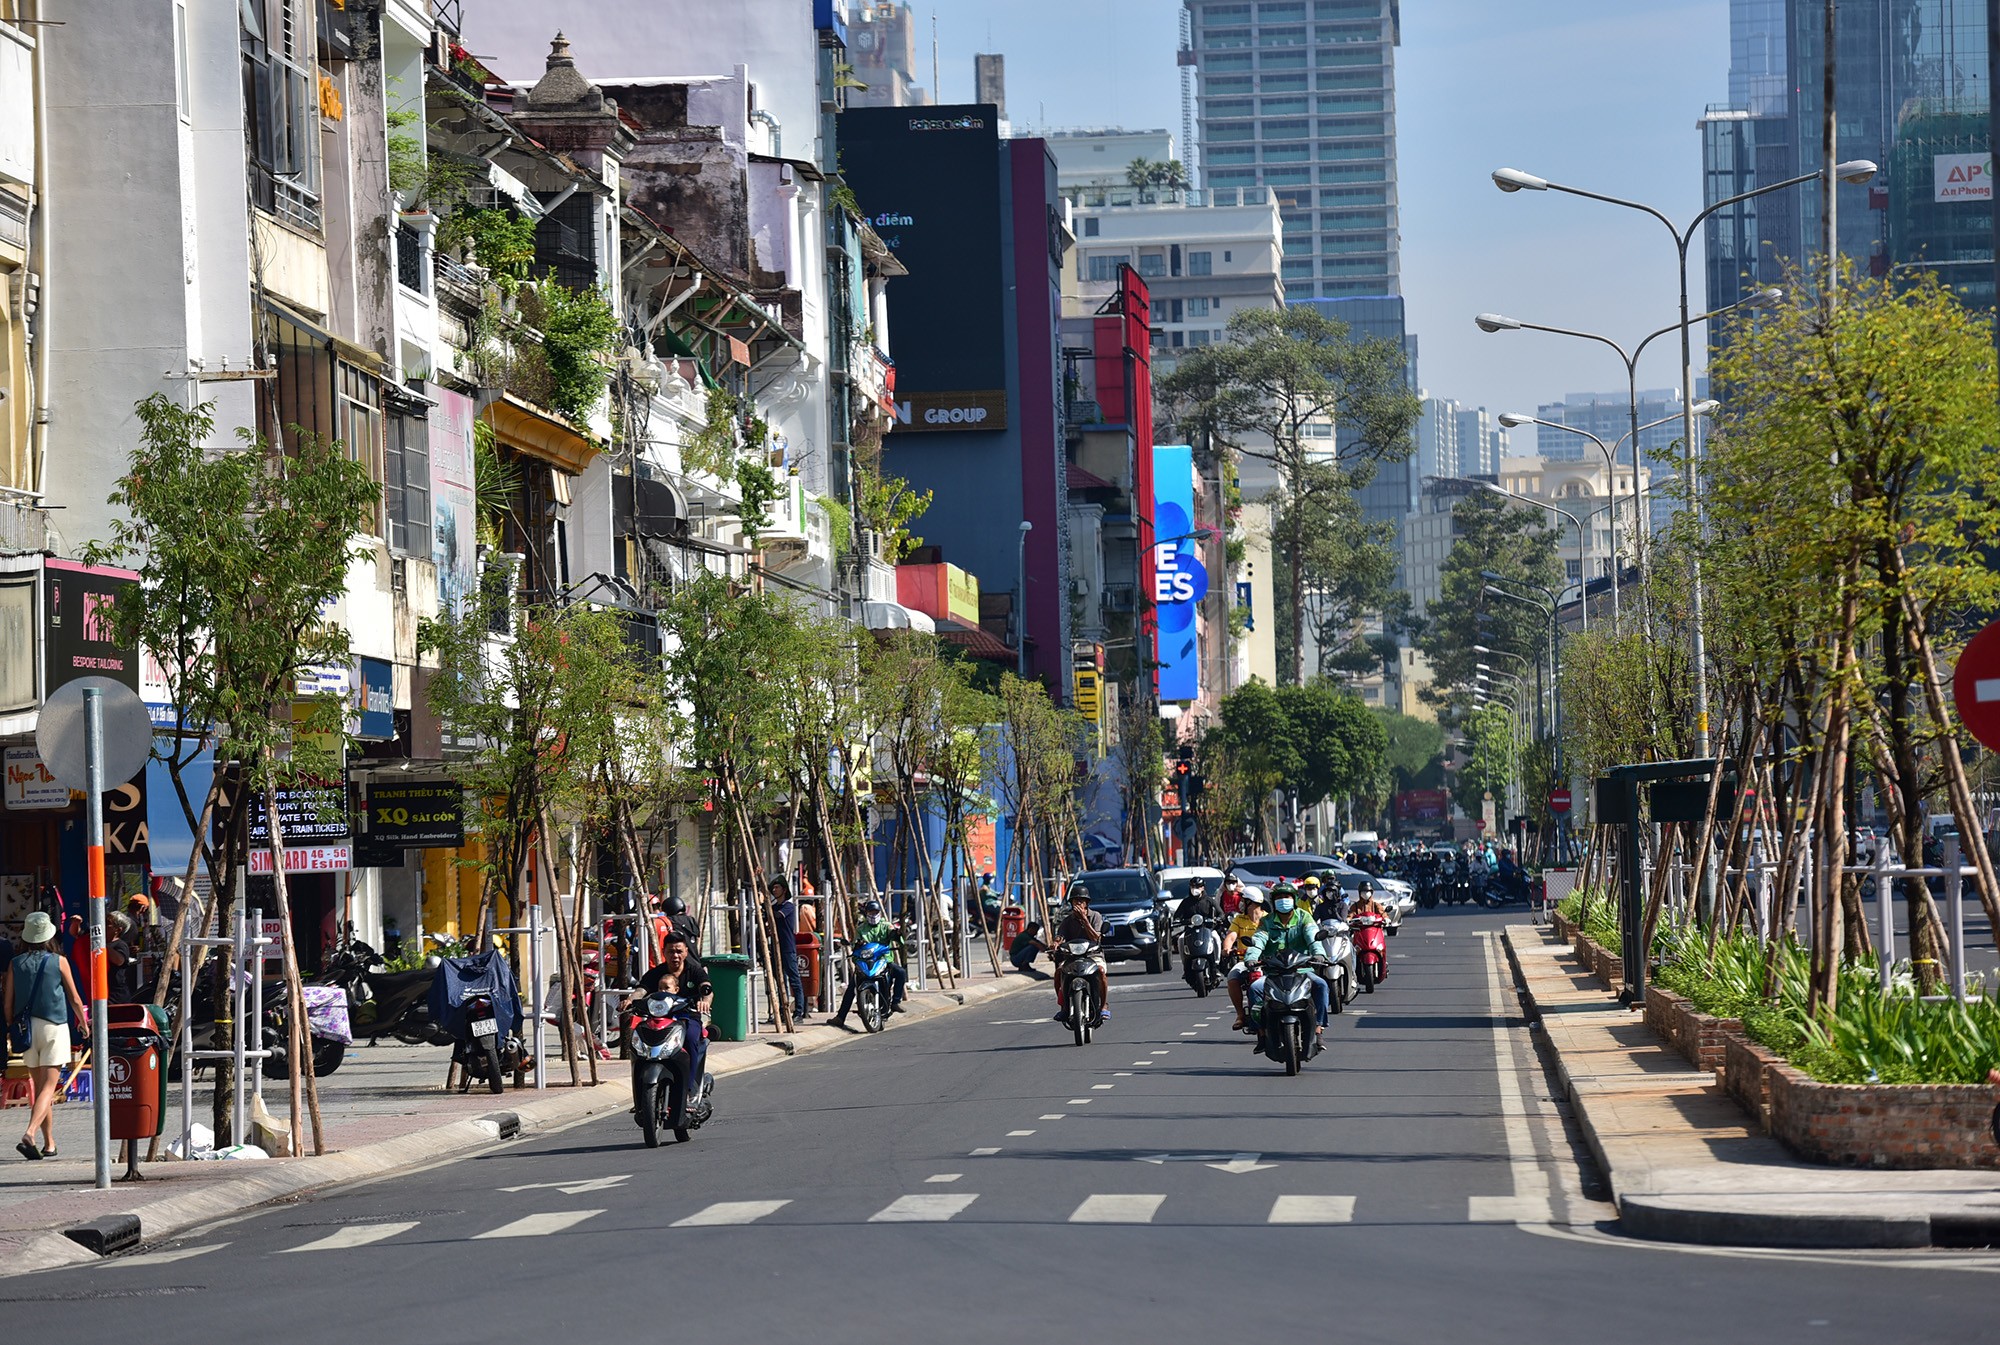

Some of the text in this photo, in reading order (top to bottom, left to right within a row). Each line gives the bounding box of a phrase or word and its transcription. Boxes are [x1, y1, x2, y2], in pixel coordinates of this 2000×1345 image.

[924, 407, 987, 424] GROUP
[1155, 543, 1179, 571] E
[1155, 572, 1195, 601] ES
[73, 656, 124, 671] BESPOKE TAILORING
[374, 790, 406, 798] TRANH
[436, 788, 455, 797] TAY
[376, 807, 409, 827] XQ
[412, 812, 431, 823] SÀI
[292, 824, 314, 835] TRAIN
[315, 824, 345, 834] TICKETS
[420, 832, 458, 840] Embroidery
[251, 850, 308, 872] SIM ARD
[311, 849, 324, 859] 4G
[333, 848, 347, 858] 5G
[311, 859, 348, 870] Esim
